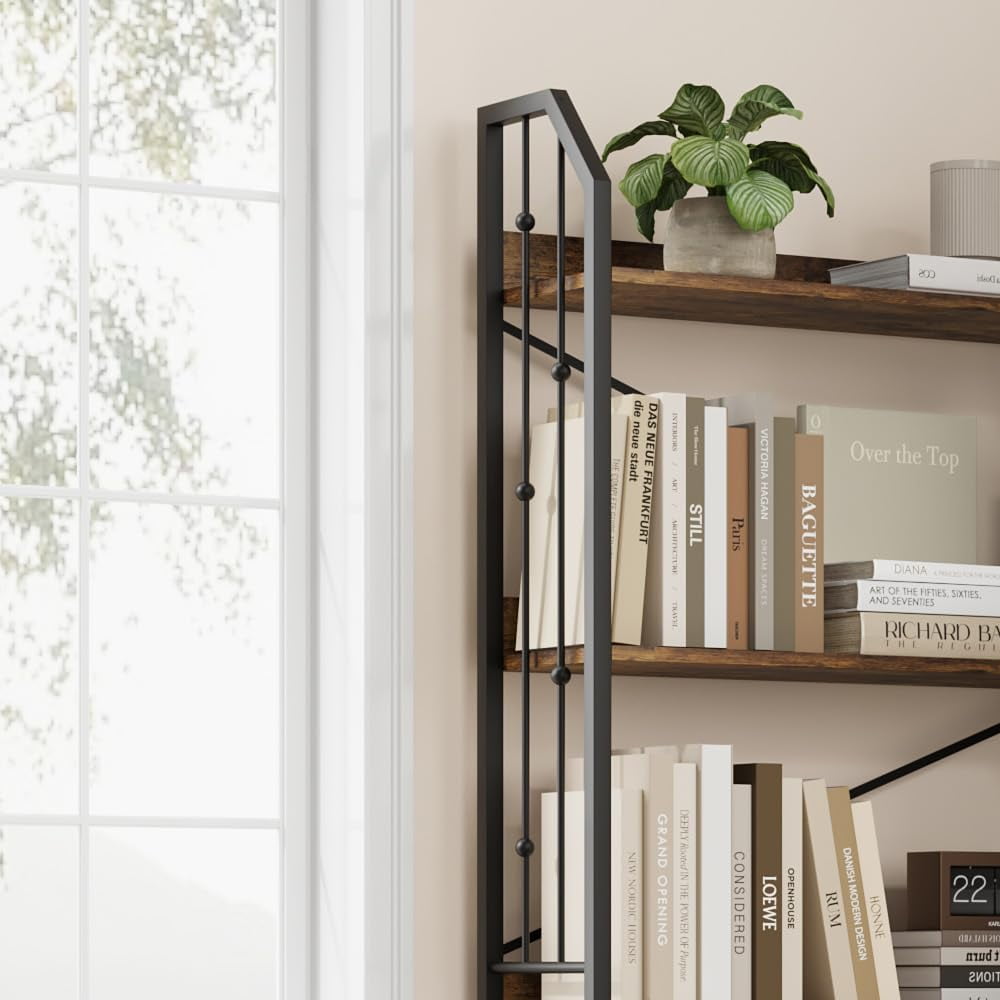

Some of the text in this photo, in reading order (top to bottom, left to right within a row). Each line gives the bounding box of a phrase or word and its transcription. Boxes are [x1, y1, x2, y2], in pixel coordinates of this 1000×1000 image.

[629, 400, 644, 482] die neue stadt
[850, 440, 960, 474] Over the Top
[640, 403, 658, 544] DAS NEUE FRANKFURT
[760, 428, 768, 520] VICTORIA HAGAN
[690, 504, 702, 546] STILL
[732, 518, 744, 552] Paris
[802, 484, 817, 608] BAGUETTE
[894, 564, 928, 576] DIANA
[869, 597, 936, 606] AND SEVENTIES
[870, 586, 982, 600] ART OF THE FIFTIES, SIXTIES,
[886, 621, 970, 641] RICHARD
[886, 640, 917, 648] THE
[680, 810, 689, 840] DEEPLY
[680, 842, 689, 870] Rooted
[657, 814, 668, 946] GRAND OPENING
[680, 872, 689, 880] IN
[680, 884, 689, 900] THE
[952, 874, 988, 902] 22
[628, 852, 636, 964] NEW NORDIC HOUSES
[680, 903, 689, 934] POWER
[734, 851, 744, 956] CONSIDERED
[762, 875, 776, 931] LOEWE
[826, 892, 842, 928] RUM
[843, 848, 868, 960] DANISH MODERN DESIGN
[870, 896, 885, 938] HONNE
[680, 936, 689, 949] OF
